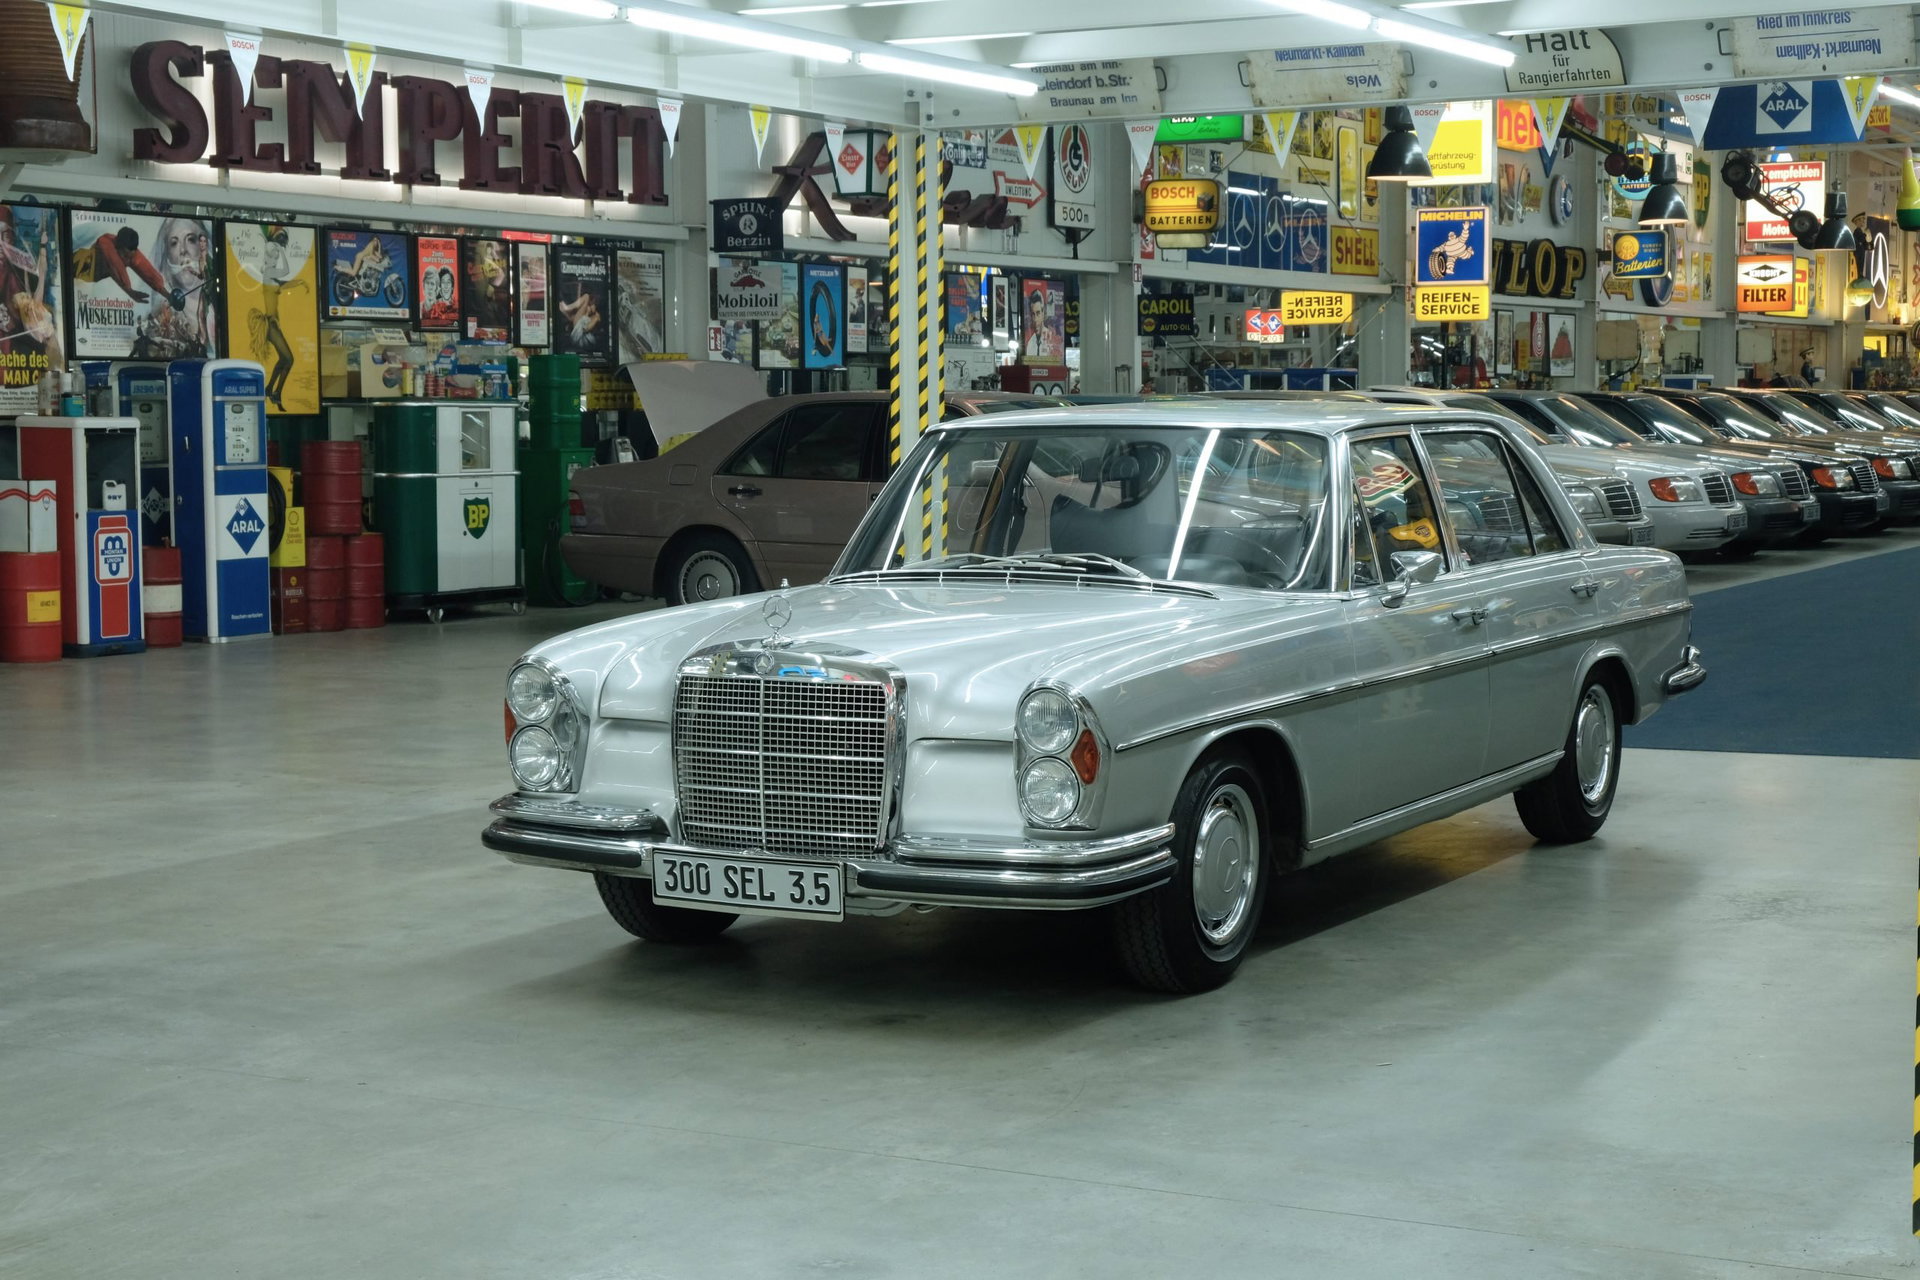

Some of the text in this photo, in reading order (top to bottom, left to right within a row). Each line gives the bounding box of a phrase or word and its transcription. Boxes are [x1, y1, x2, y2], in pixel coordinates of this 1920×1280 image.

[1756, 11, 1852, 30] Ried im Innkreis
[231, 40, 255, 50] BOSCH
[1526, 29, 1592, 53] Halt
[1552, 54, 1571, 67] für
[469, 75, 488, 86] BOSCH
[1346, 74, 1382, 89] Wels
[1519, 68, 1611, 87] Rangierfahrten
[1050, 93, 1138, 108] Braunau am Inn
[1684, 94, 1711, 102] BOSCH
[661, 103, 678, 113] BOSCH
[1414, 109, 1439, 117] BOSCH
[1766, 100, 1803, 112] ARAL
[130, 40, 679, 206] SEMPERIT
[1131, 125, 1154, 133] BOSCH
[1427, 151, 1477, 162] aftfahrzeug-
[1431, 161, 1466, 170] srüstung
[1769, 166, 1820, 182] empfehlen
[1005, 184, 1032, 197] UMLEITUNG
[1151, 186, 1196, 200] BOSCH
[722, 200, 775, 221] SPHIN
[1420, 210, 1484, 221] MICHELIN
[1150, 215, 1212, 226] BATTERIEN
[1335, 235, 1376, 267] SHELL
[733, 268, 762, 278] GAROYLE
[1493, 238, 1583, 298] LOP
[1615, 256, 1663, 275] Batterien
[718, 293, 778, 309] Mobiloil
[1743, 288, 1787, 303] FILTER
[1139, 299, 1192, 315] CAROIL
[1421, 304, 1480, 315] SERVICE
[77, 301, 135, 330] MUSKETIER
[0, 350, 49, 368] ache des
[4, 370, 29, 385] MAN
[224, 385, 257, 394] ARAL SUPER
[467, 504, 490, 529] BP
[231, 519, 261, 534] ARAL
[663, 858, 831, 907] 300 SEL 3.5
